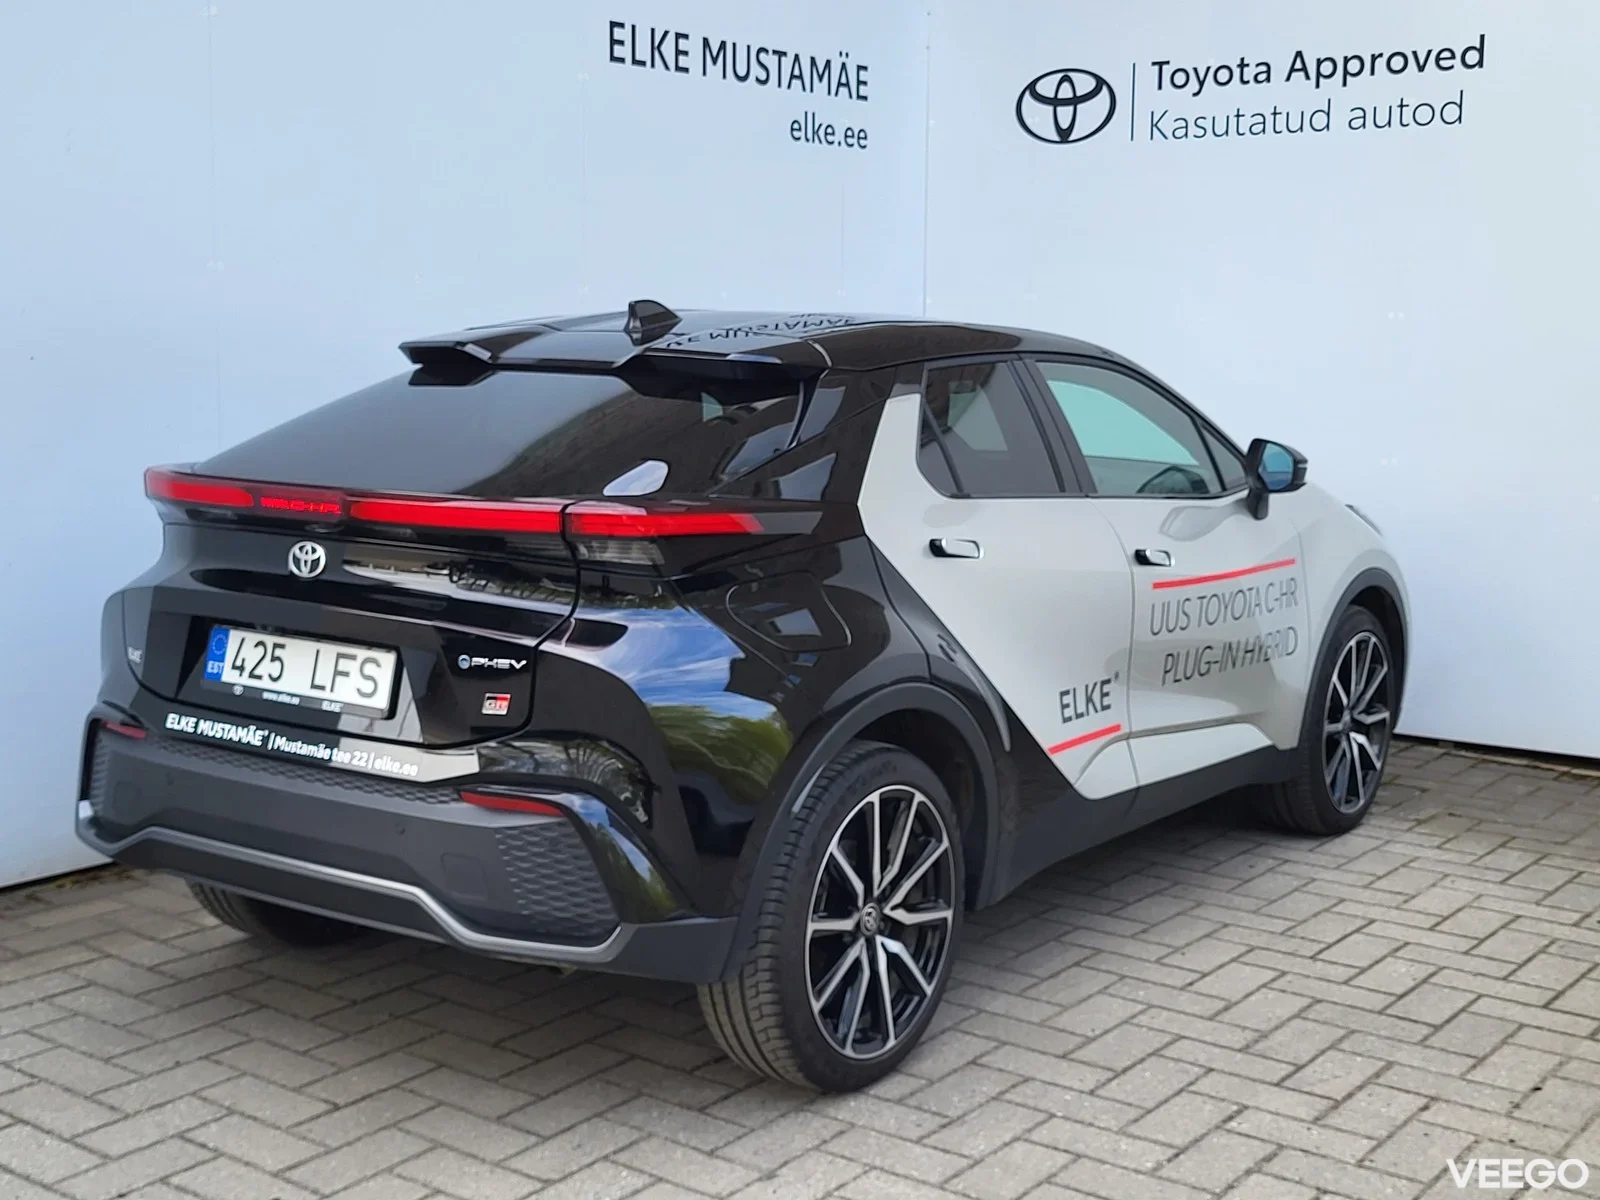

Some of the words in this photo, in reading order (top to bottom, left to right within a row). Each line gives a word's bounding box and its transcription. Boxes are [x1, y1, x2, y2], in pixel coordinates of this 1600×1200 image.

[609, 20, 690, 74] ELKE
[702, 36, 869, 102] MUSTAMÄE
[1151, 56, 1271, 97] Toyota
[1285, 34, 1485, 89] Approved
[790, 110, 868, 149] elke.ee
[1150, 98, 1331, 141] Kasutatud
[1348, 90, 1463, 132] autod
[1150, 598, 1192, 636] UUS
[1197, 587, 1263, 628] TOYOTA
[1264, 577, 1299, 613] C-HR
[206, 660, 225, 675] EST
[231, 636, 286, 683] 425
[310, 649, 382, 698] LFS
[471, 657, 527, 669] PHEV
[1161, 640, 1240, 687] PLUG-IN
[165, 713, 198, 733] ELKE
[351, 750, 368, 767] 22
